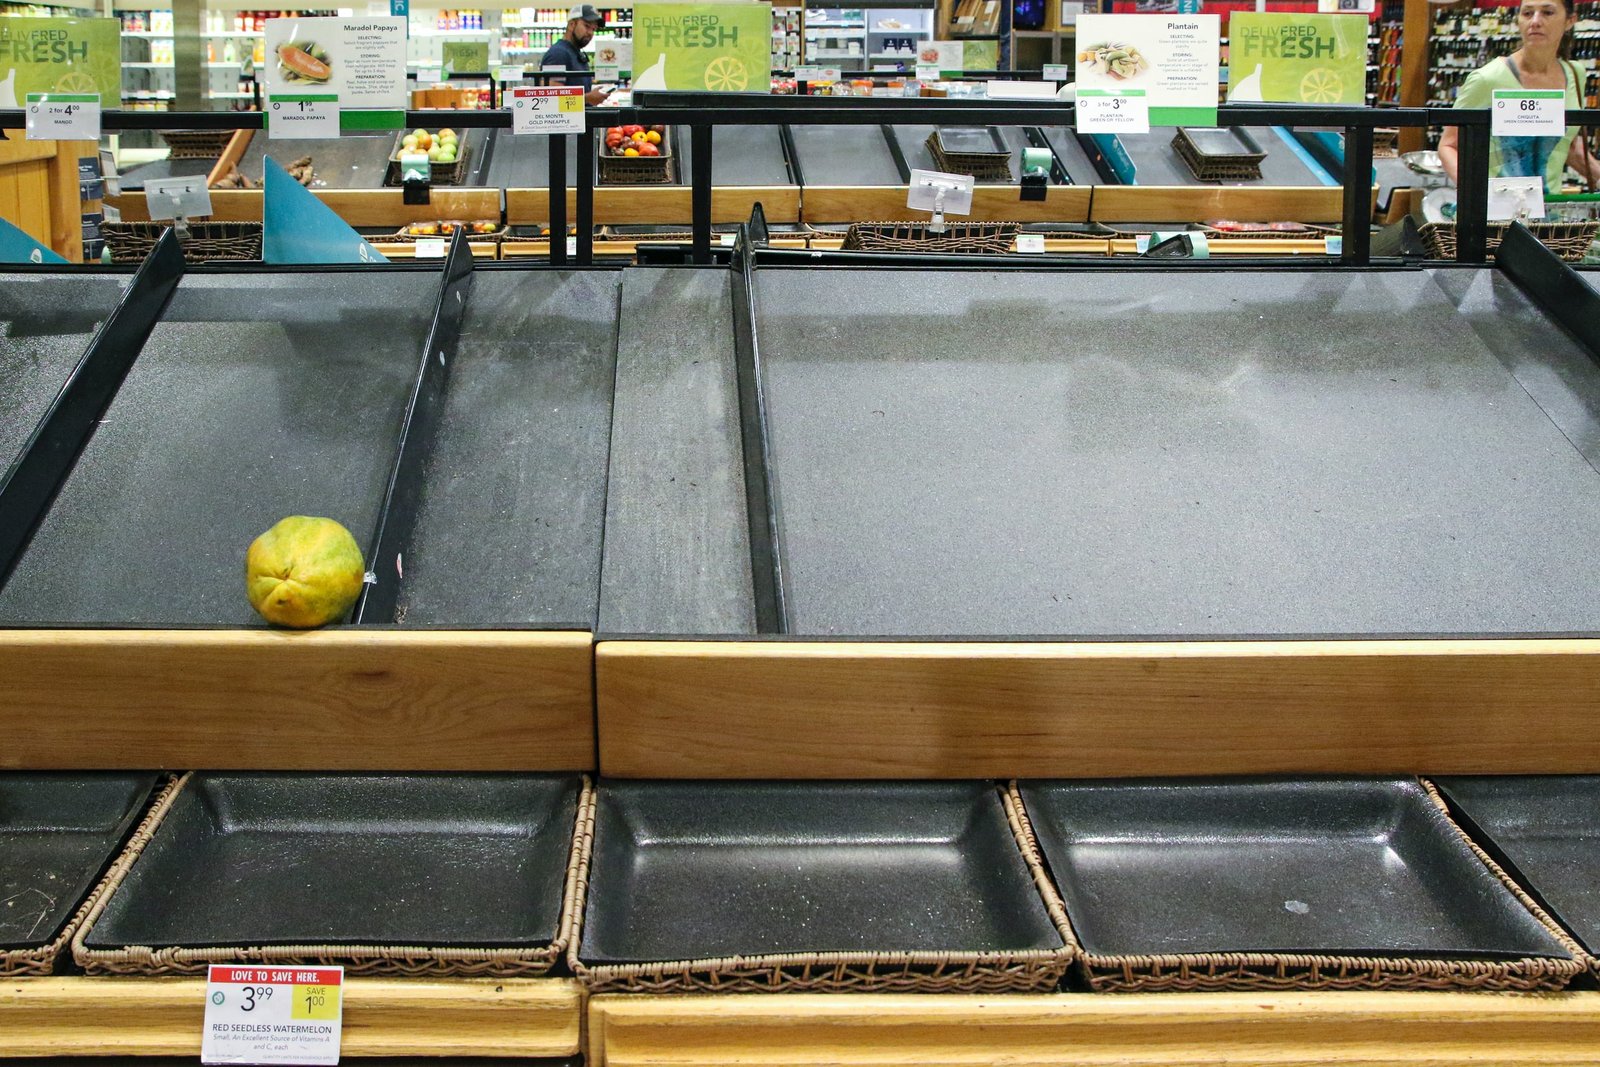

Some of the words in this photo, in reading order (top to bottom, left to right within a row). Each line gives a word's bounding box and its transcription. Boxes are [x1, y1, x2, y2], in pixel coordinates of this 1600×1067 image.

[642, 15, 719, 28] DELIVERED
[373, 24, 398, 32] Papaya
[1240, 25, 1317, 37] DELIVERED
[0, 29, 68, 41] ELIVERED
[646, 25, 738, 48] FRESH
[1244, 35, 1335, 59] FRESH
[231, 970, 253, 981] LOVE
[256, 970, 268, 981] TO
[271, 971, 293, 982] SAVE
[296, 972, 320, 983] HERE.
[306, 986, 326, 995] SAVE
[212, 1023, 229, 1031] RED
[230, 1023, 271, 1033] SEEDLESS
[273, 1024, 332, 1034] WATERMELON
[270, 1034, 291, 1042] Source
